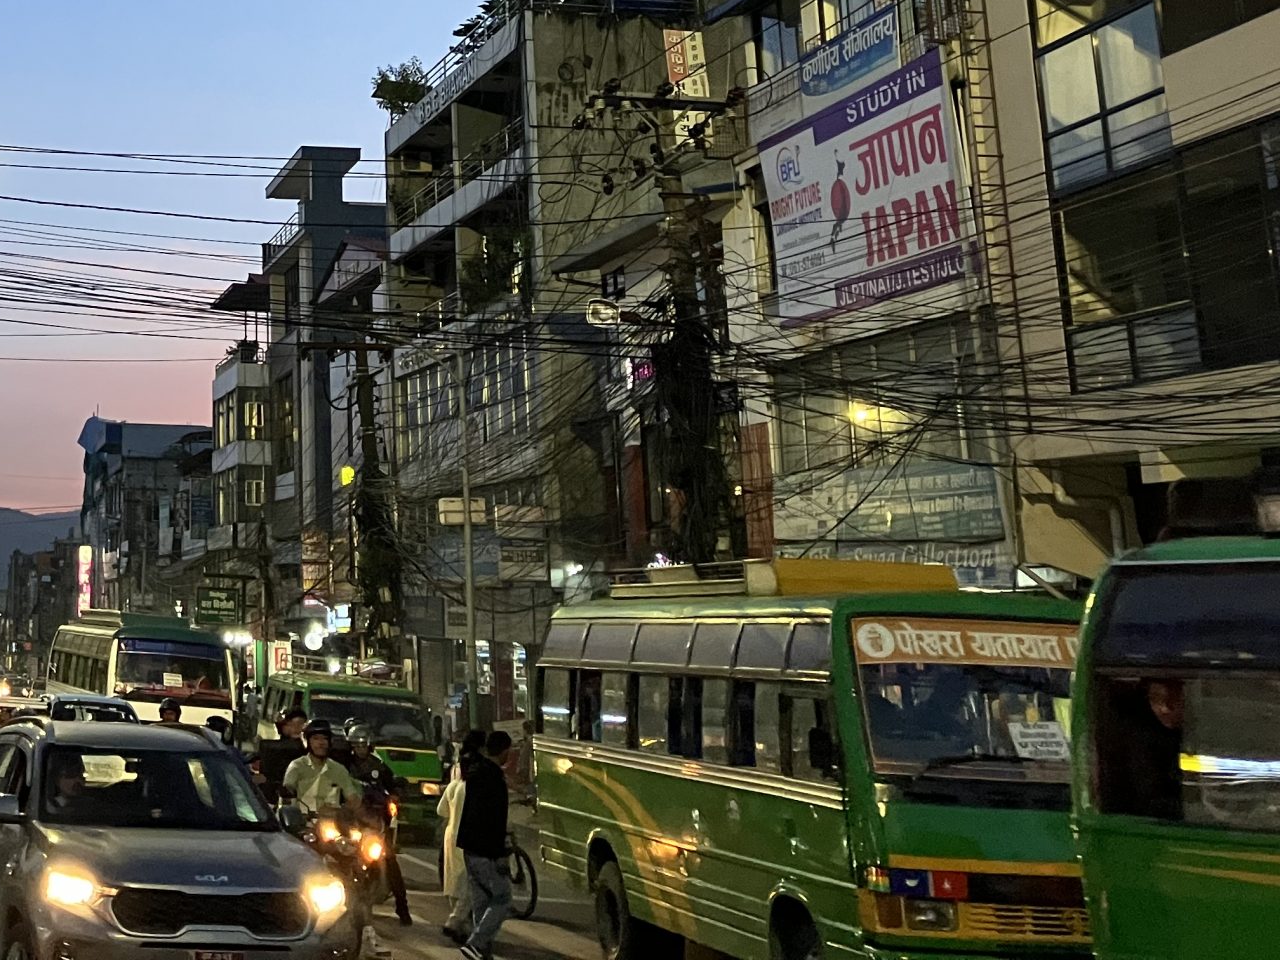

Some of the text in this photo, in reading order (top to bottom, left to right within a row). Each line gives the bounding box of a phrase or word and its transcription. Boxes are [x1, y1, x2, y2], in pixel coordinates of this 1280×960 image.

[846, 78, 900, 122] STUDY
[905, 66, 926, 94] IN
[849, 103, 948, 196] जापान
[862, 179, 961, 267] JAPAN
[901, 542, 994, 569] Collection
[893, 622, 965, 657] पोखरा
[966, 630, 1063, 662] यातायात
